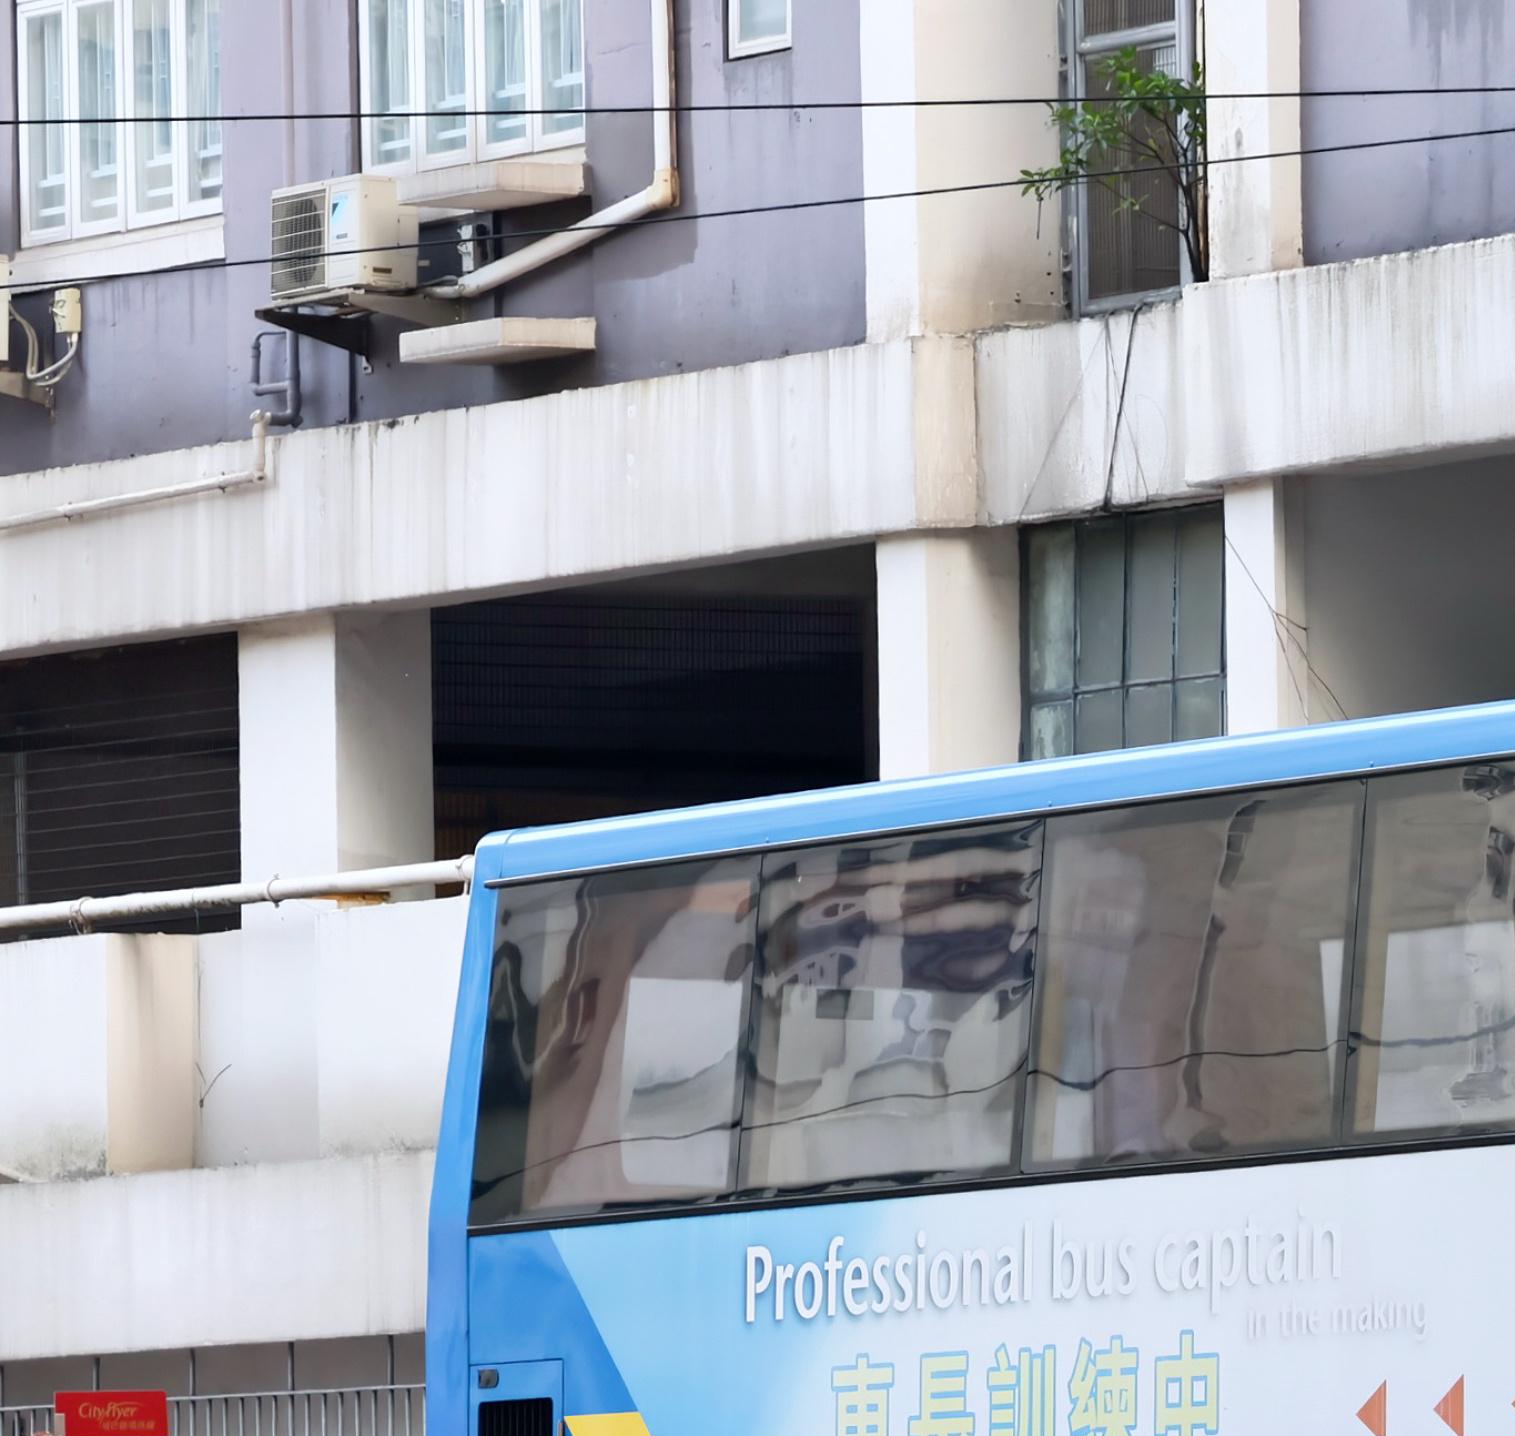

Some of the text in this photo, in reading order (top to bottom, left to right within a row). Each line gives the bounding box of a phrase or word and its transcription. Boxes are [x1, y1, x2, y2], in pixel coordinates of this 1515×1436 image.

[744, 1206, 1342, 1324] Professional bus captain
[1245, 1293, 1428, 1342] in the making
